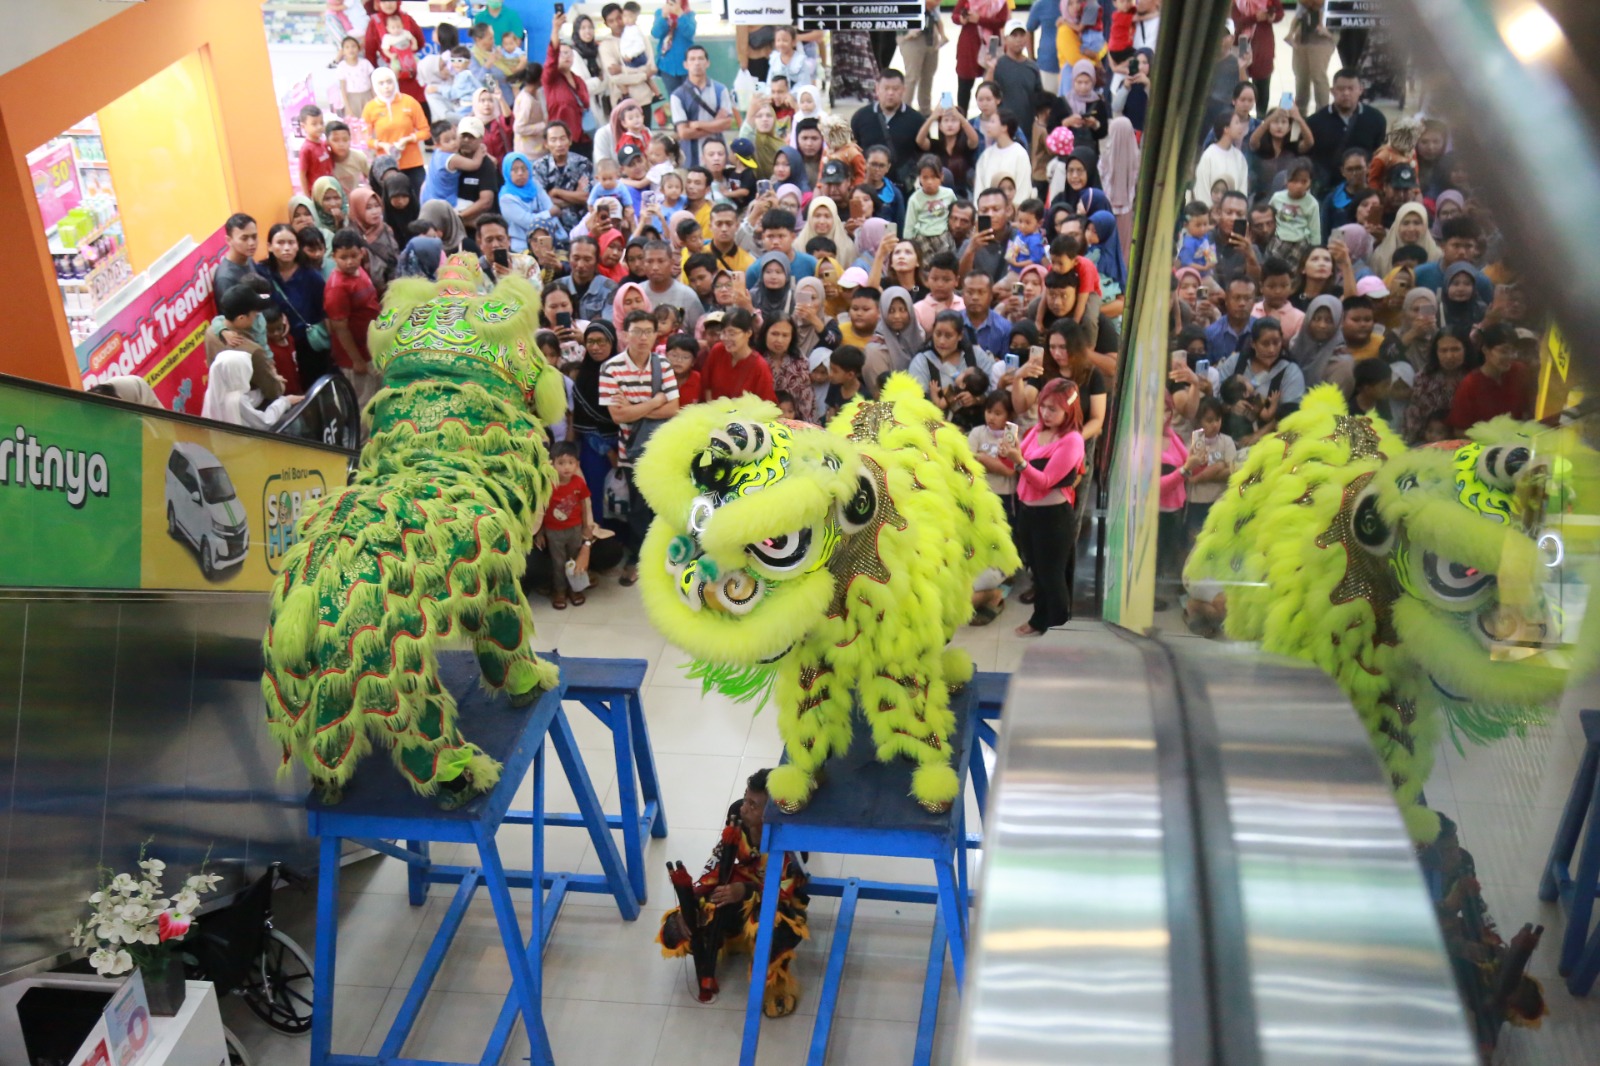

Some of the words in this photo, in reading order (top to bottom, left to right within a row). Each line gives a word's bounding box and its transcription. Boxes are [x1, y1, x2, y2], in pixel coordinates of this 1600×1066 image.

[852, 6, 898, 14] GRAMEDIA
[0, 425, 109, 508] ritnya
[281, 467, 291, 481] Ini
[292, 467, 308, 480] Baru
